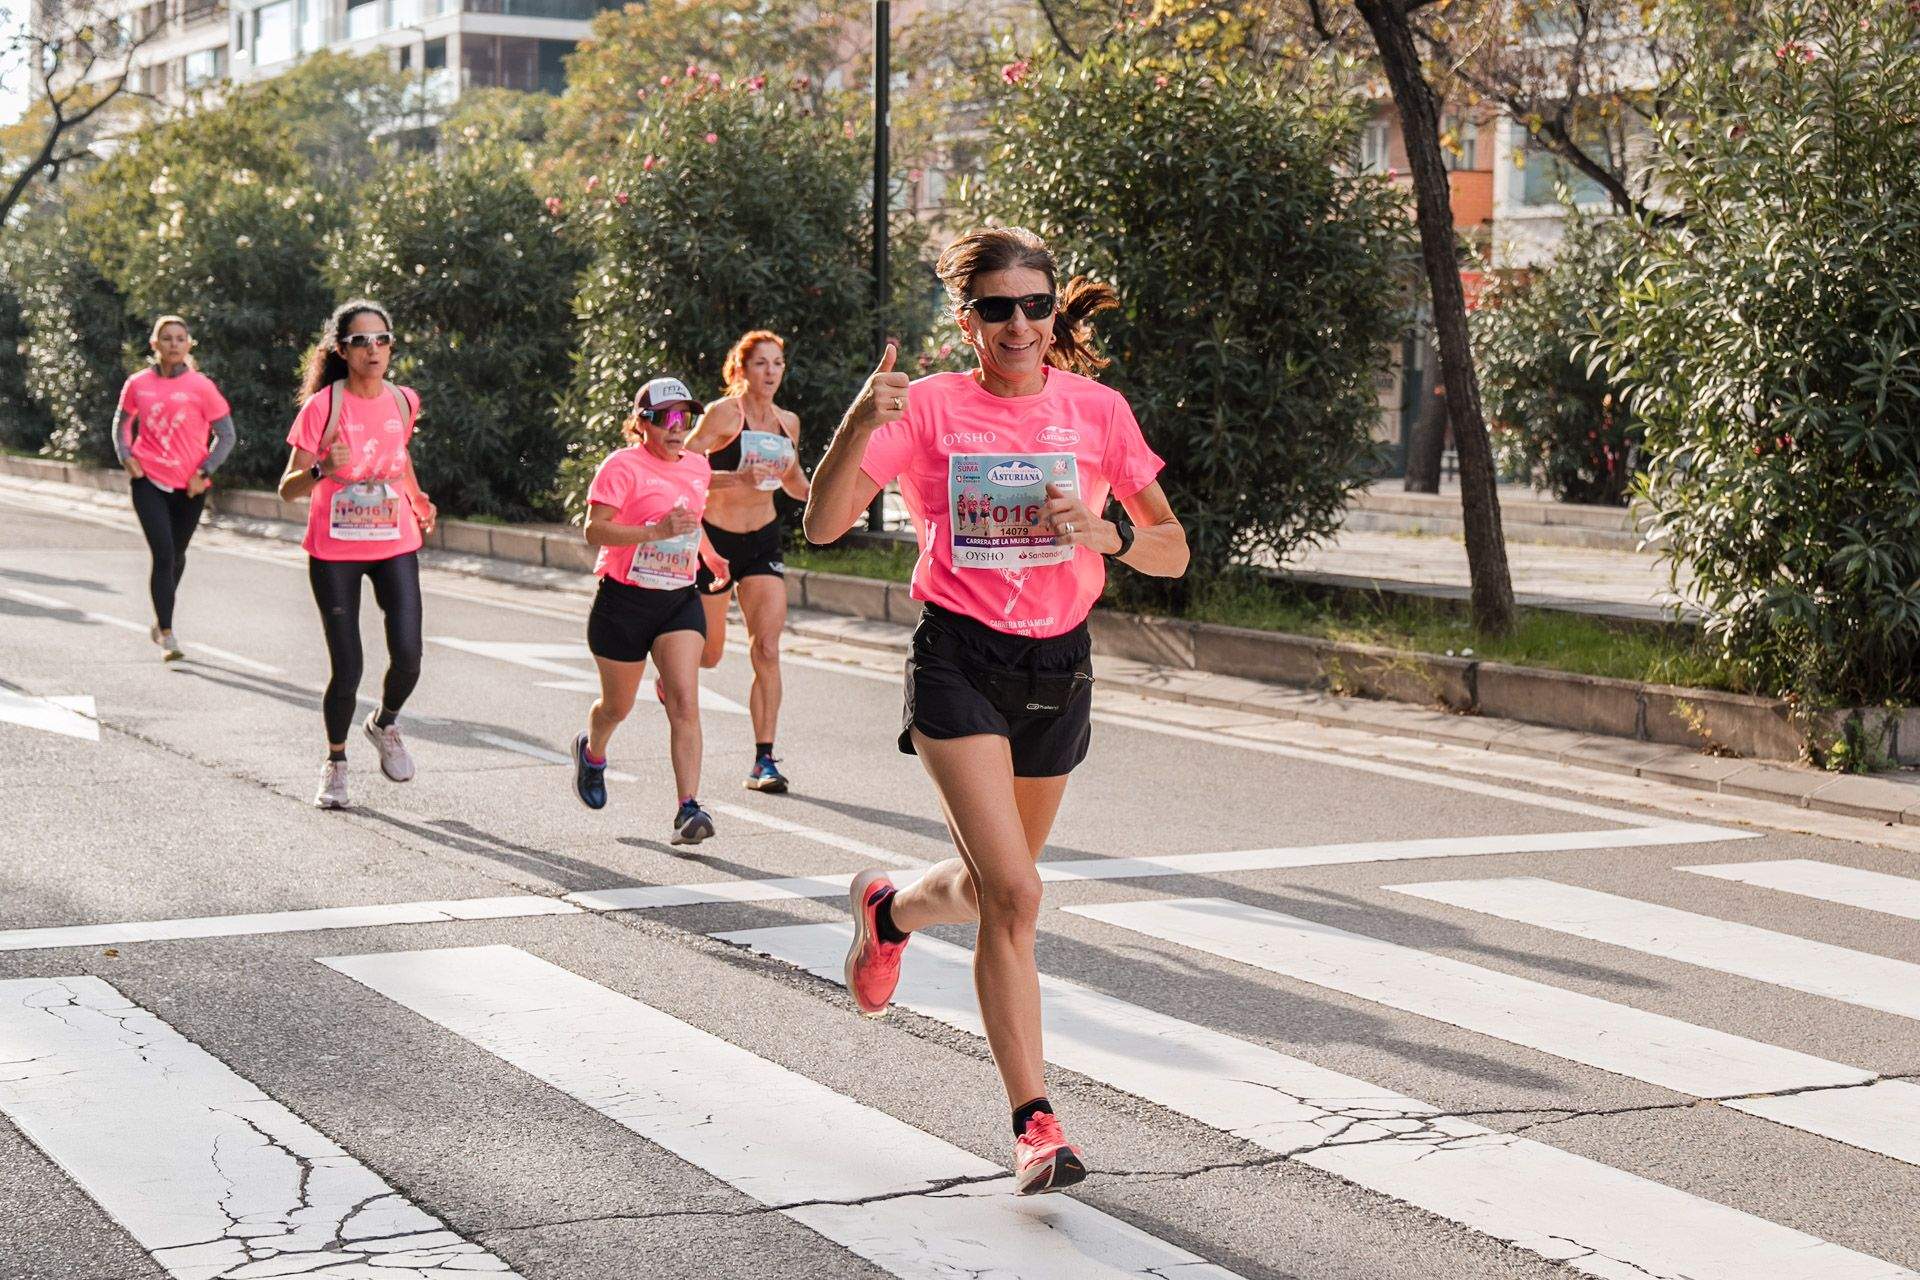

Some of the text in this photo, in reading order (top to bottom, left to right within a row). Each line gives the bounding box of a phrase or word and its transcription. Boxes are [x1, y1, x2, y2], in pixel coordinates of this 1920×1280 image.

[943, 431, 996, 446] OYSHO
[1040, 433, 1077, 441] ASTURIANA
[991, 470, 1040, 480] ASTURIANA
[355, 506, 380, 516] 016
[1000, 527, 1028, 536] 14079
[966, 537, 991, 546] CARRERA
[992, 538, 1000, 546] DE
[1010, 537, 1030, 545] MUJER
[656, 551, 679, 564] 016
[966, 551, 1004, 561] OYSHO
